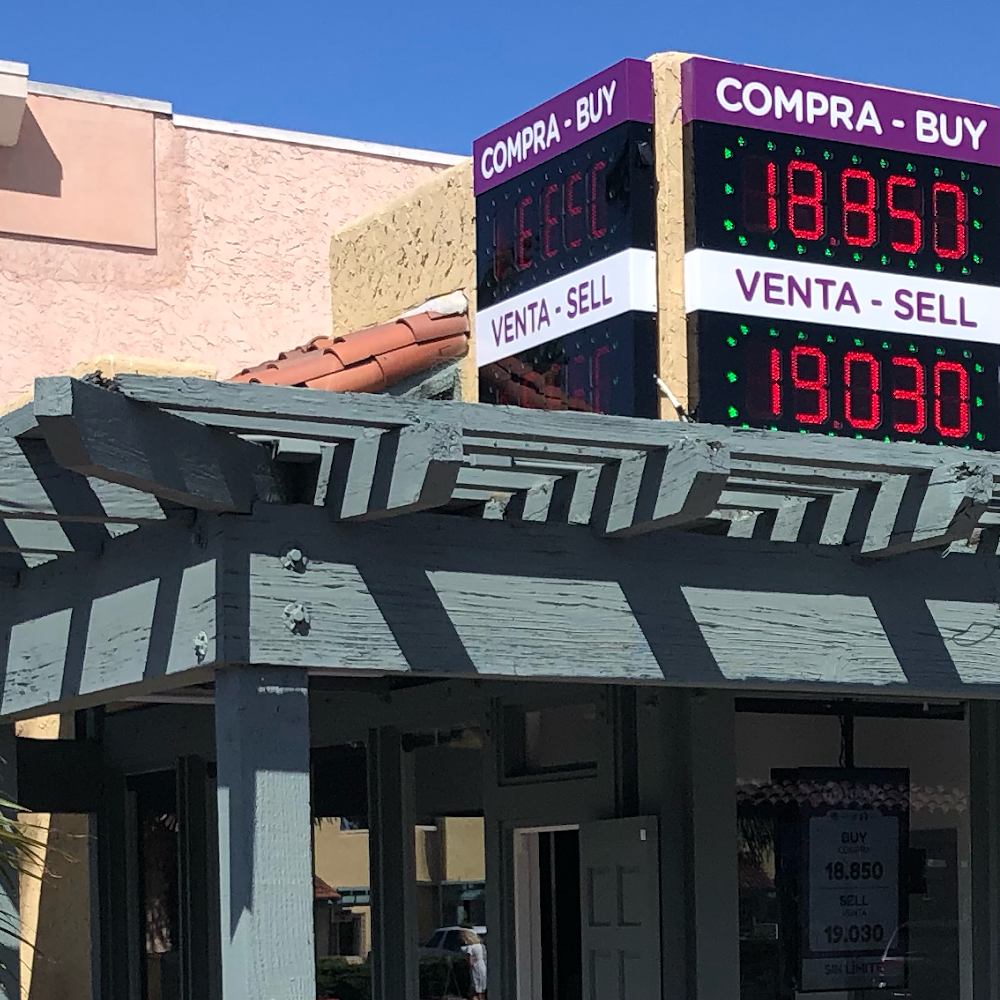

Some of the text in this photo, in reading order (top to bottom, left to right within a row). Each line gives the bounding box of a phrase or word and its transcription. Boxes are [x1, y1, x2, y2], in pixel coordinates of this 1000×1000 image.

[481, 113, 561, 180] COMPRA
[576, 79, 617, 132] BUY
[716, 77, 883, 136] COMPRA
[916, 109, 987, 151] BUY
[491, 298, 551, 348] VENTA
[566, 274, 613, 319] SELL
[735, 268, 861, 315] VENTA
[894, 288, 978, 329] SELL
[841, 831, 868, 844] BUY
[825, 861, 884, 881] 18.850
[839, 894, 869, 906] SELL
[824, 924, 884, 943] 19.030
